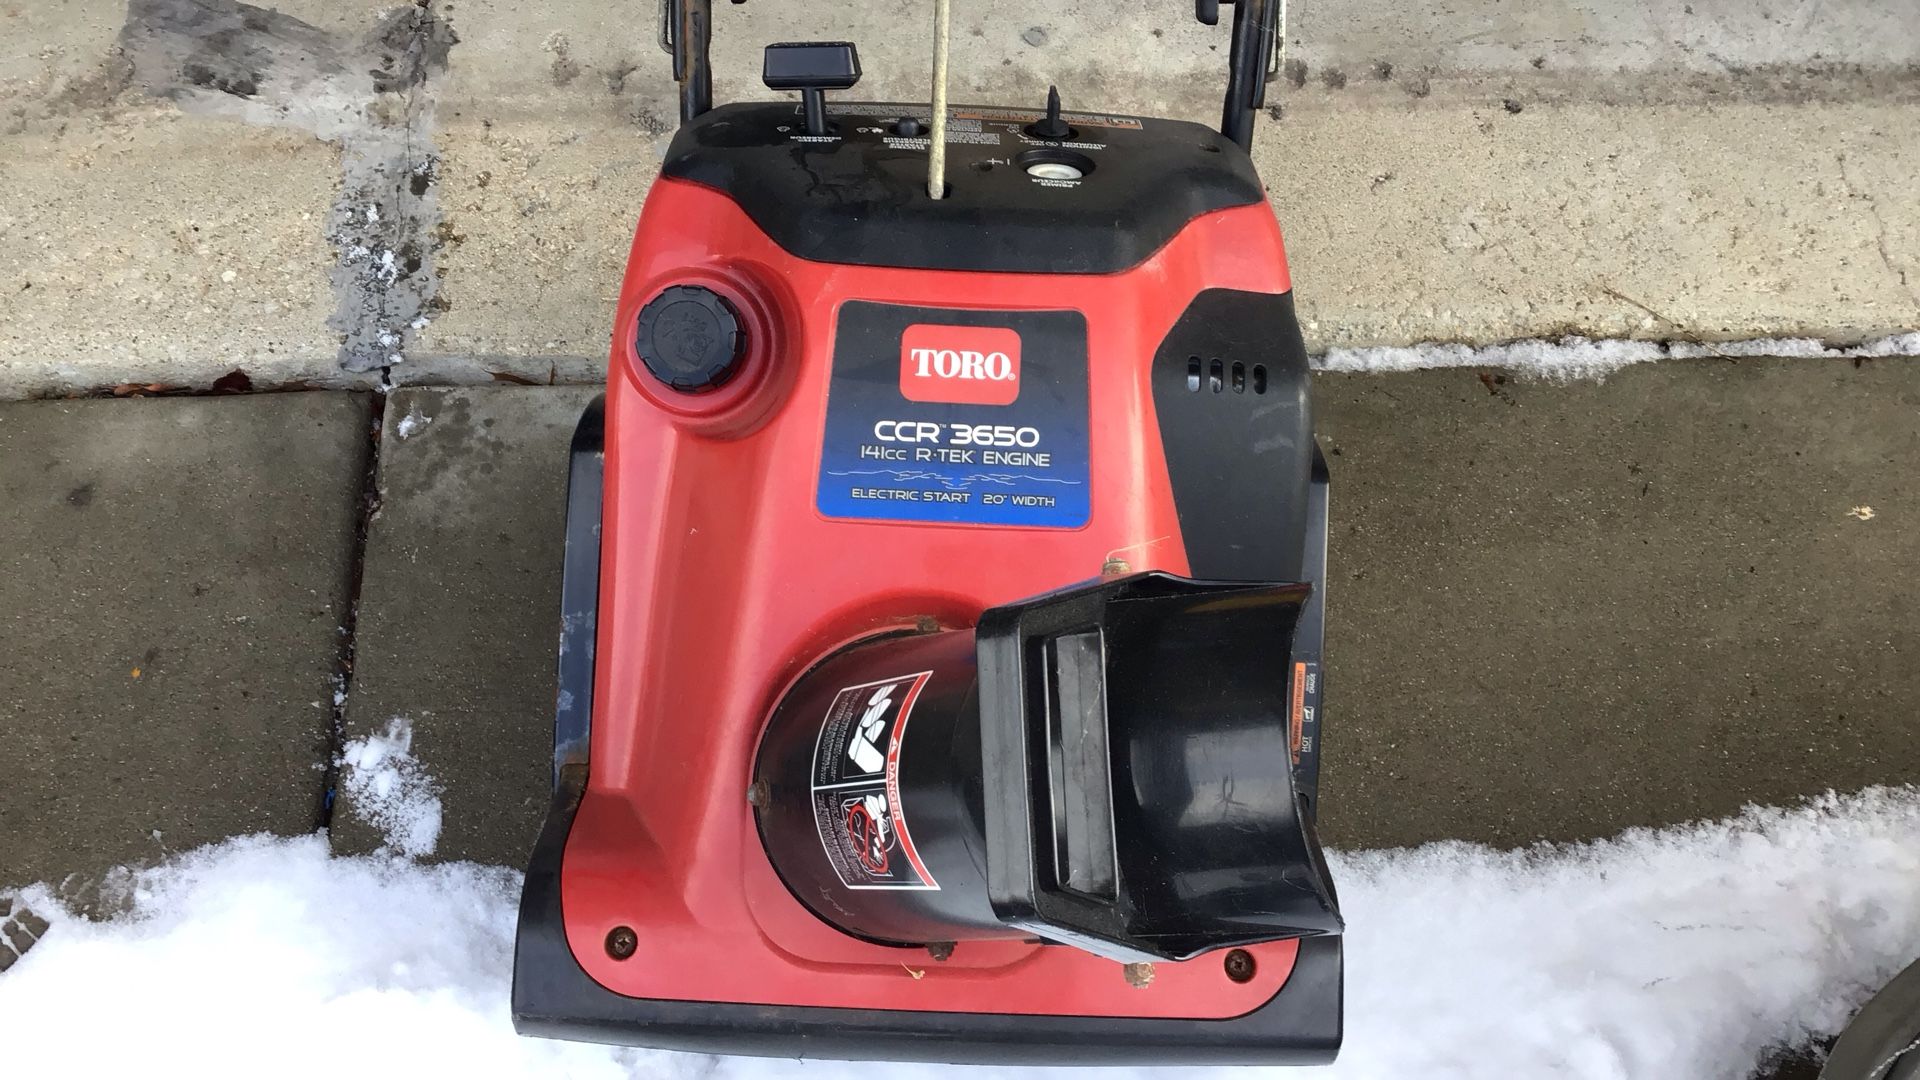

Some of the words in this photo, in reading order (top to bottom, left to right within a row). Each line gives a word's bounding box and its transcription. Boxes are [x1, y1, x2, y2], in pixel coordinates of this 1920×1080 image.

[911, 348, 1011, 380] TORO
[949, 424, 1040, 447] 3650
[983, 451, 1051, 467] ENGINE
[852, 488, 919, 501] ELECTRIC
[923, 490, 971, 503] START
[1012, 495, 1055, 507] WIDTH
[887, 761, 902, 821] DANGER
